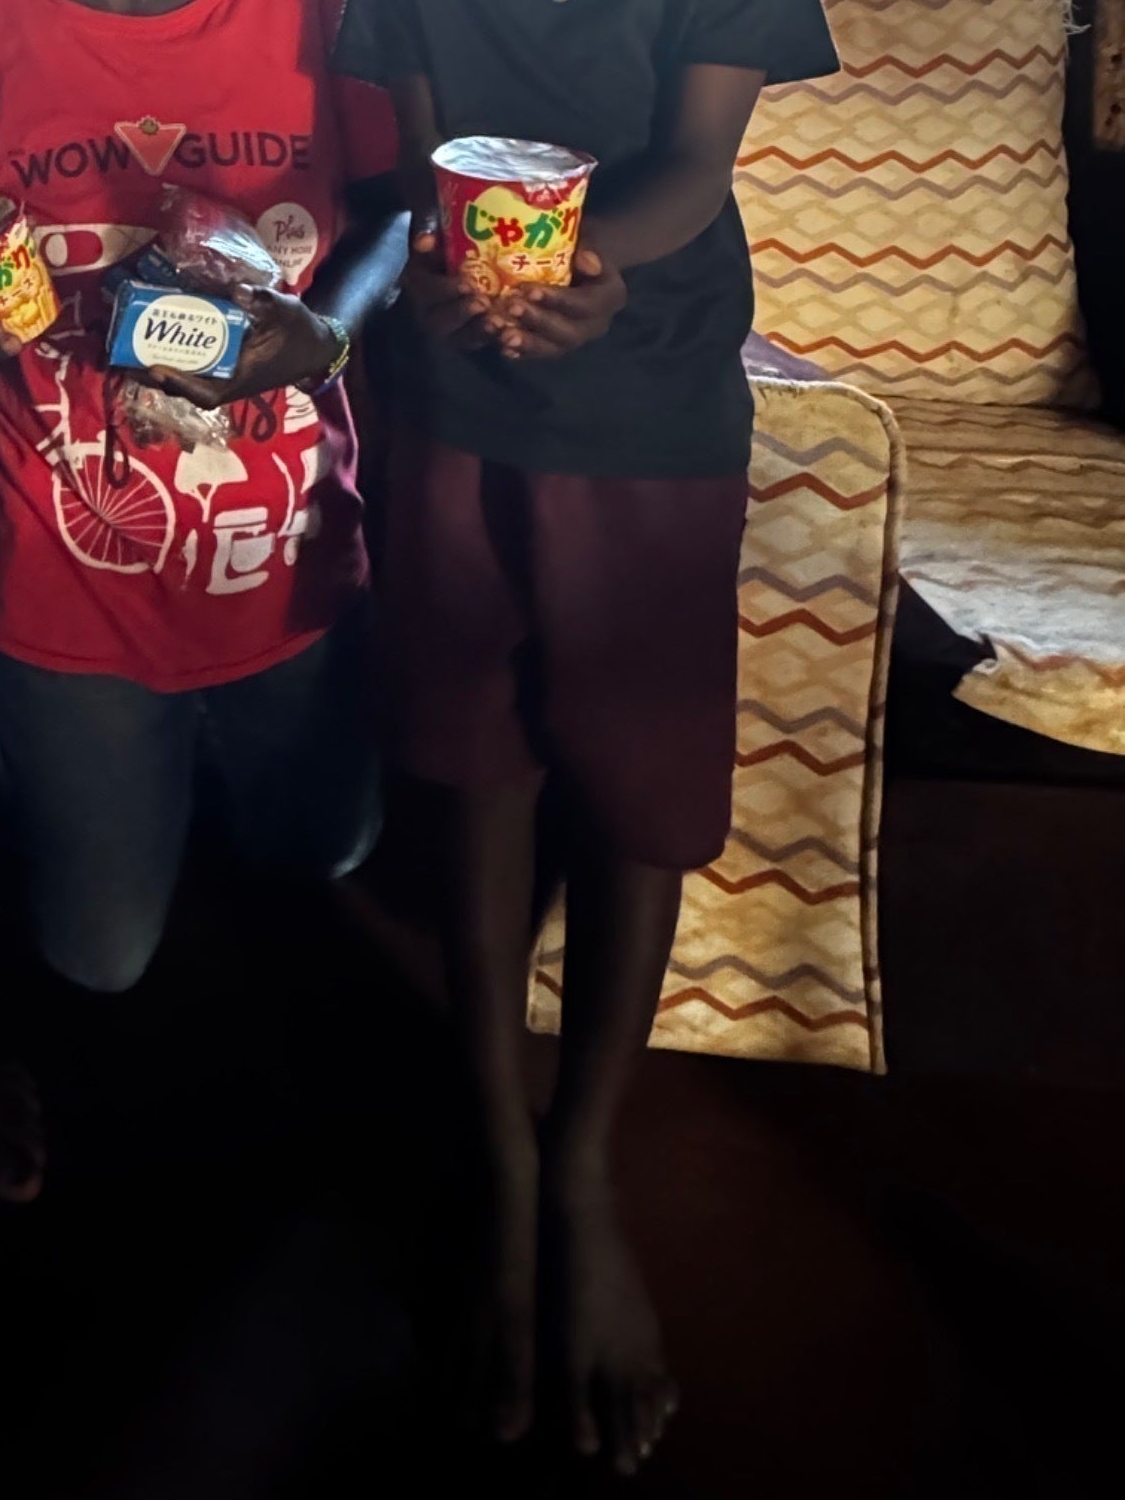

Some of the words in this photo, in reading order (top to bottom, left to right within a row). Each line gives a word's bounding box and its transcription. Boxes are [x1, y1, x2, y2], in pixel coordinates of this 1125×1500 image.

[11, 135, 130, 188] WOW
[174, 131, 312, 170] GUIDE
[144, 317, 217, 349] White
